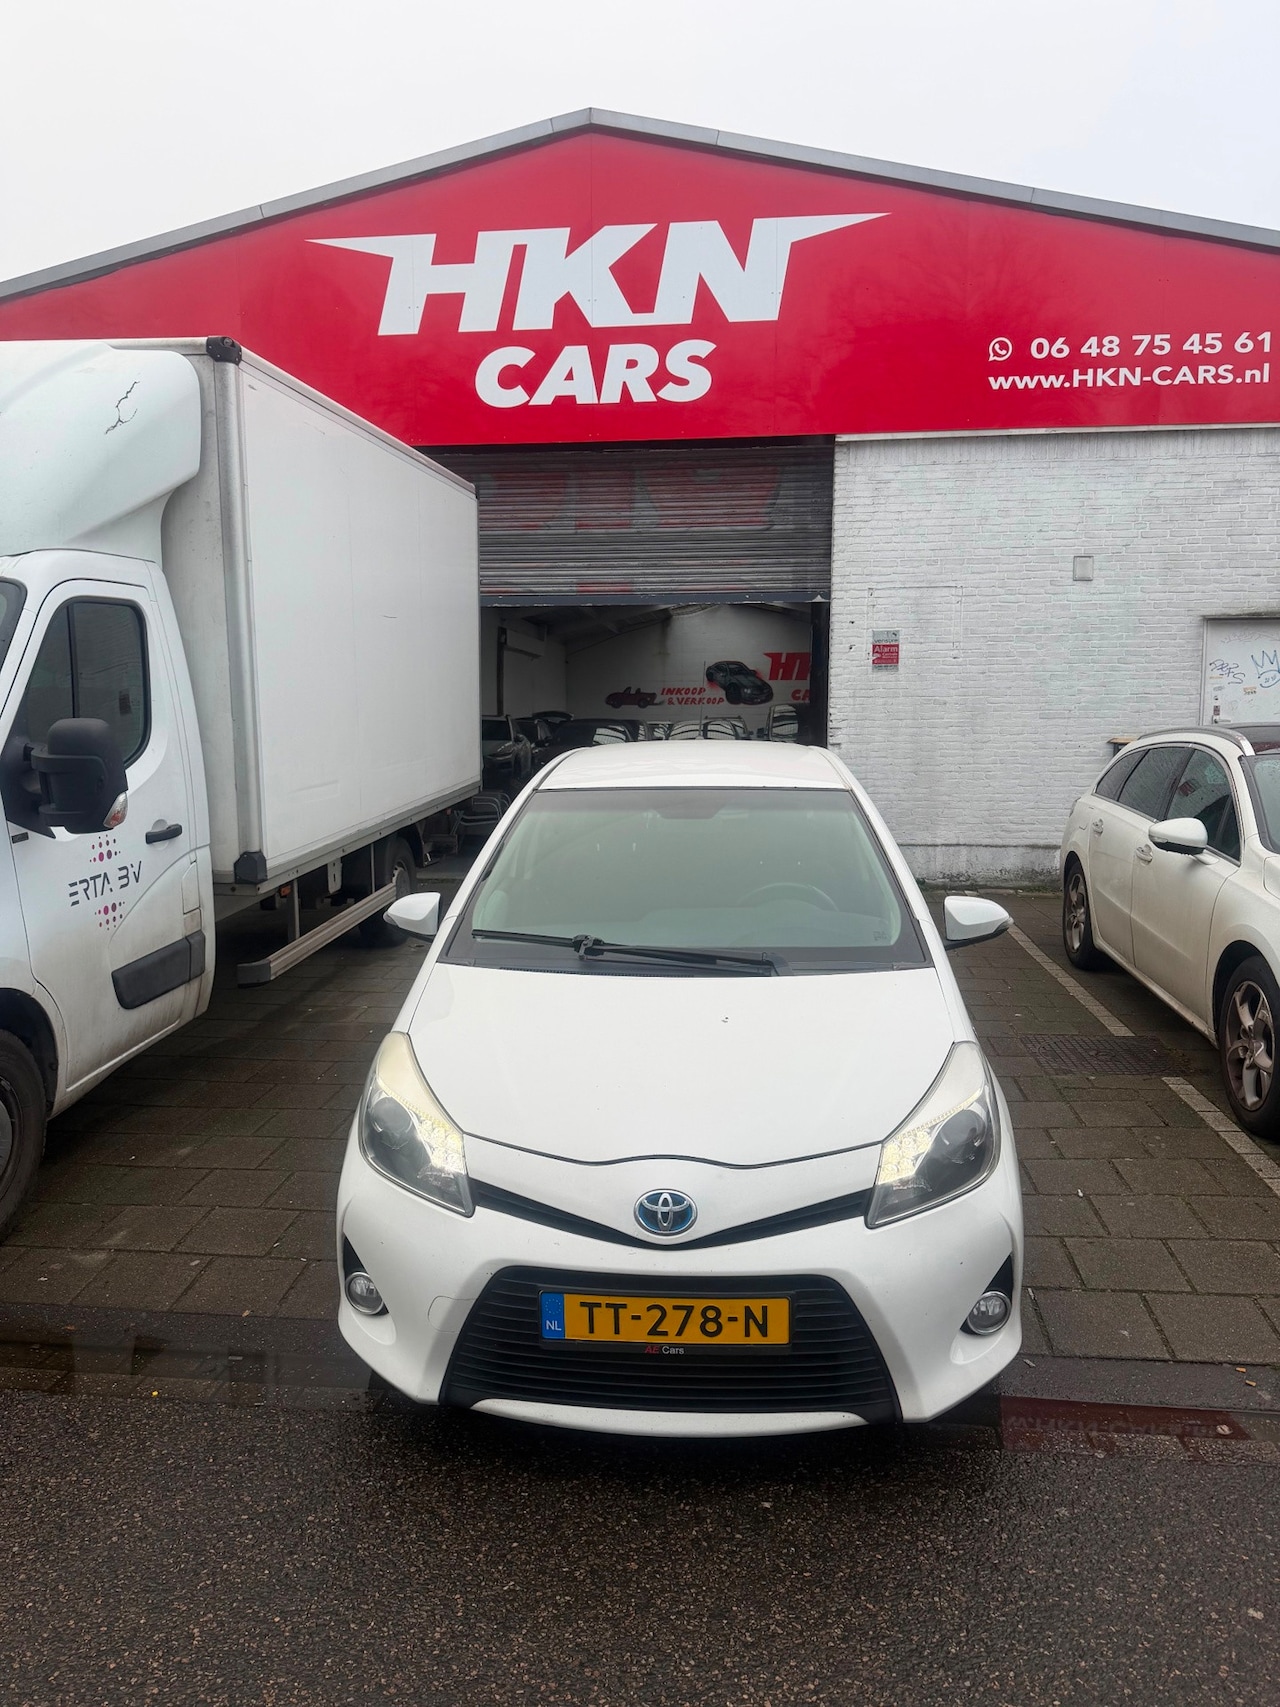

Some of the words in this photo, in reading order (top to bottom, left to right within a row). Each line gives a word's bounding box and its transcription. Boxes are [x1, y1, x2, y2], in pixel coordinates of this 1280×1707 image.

[304, 212, 892, 336] HKN
[1030, 336, 1070, 359] 06
[1080, 335, 1120, 358] 48
[1131, 333, 1171, 356] 75
[1182, 332, 1223, 354] 45
[1233, 331, 1272, 353] 61
[475, 339, 717, 408] CARS
[988, 363, 1271, 390] www.HKN-CARS.nl
[874, 645, 898, 653] Alarm
[660, 687, 706, 696] INKOOP
[676, 697, 725, 706] VERKOOP
[68, 872, 114, 907] ERTA
[117, 860, 142, 890] BV
[545, 1319, 562, 1331] NL
[580, 1301, 768, 1338] TT-278-N
[644, 1345, 660, 1354] AE
[662, 1345, 685, 1355] Cars
